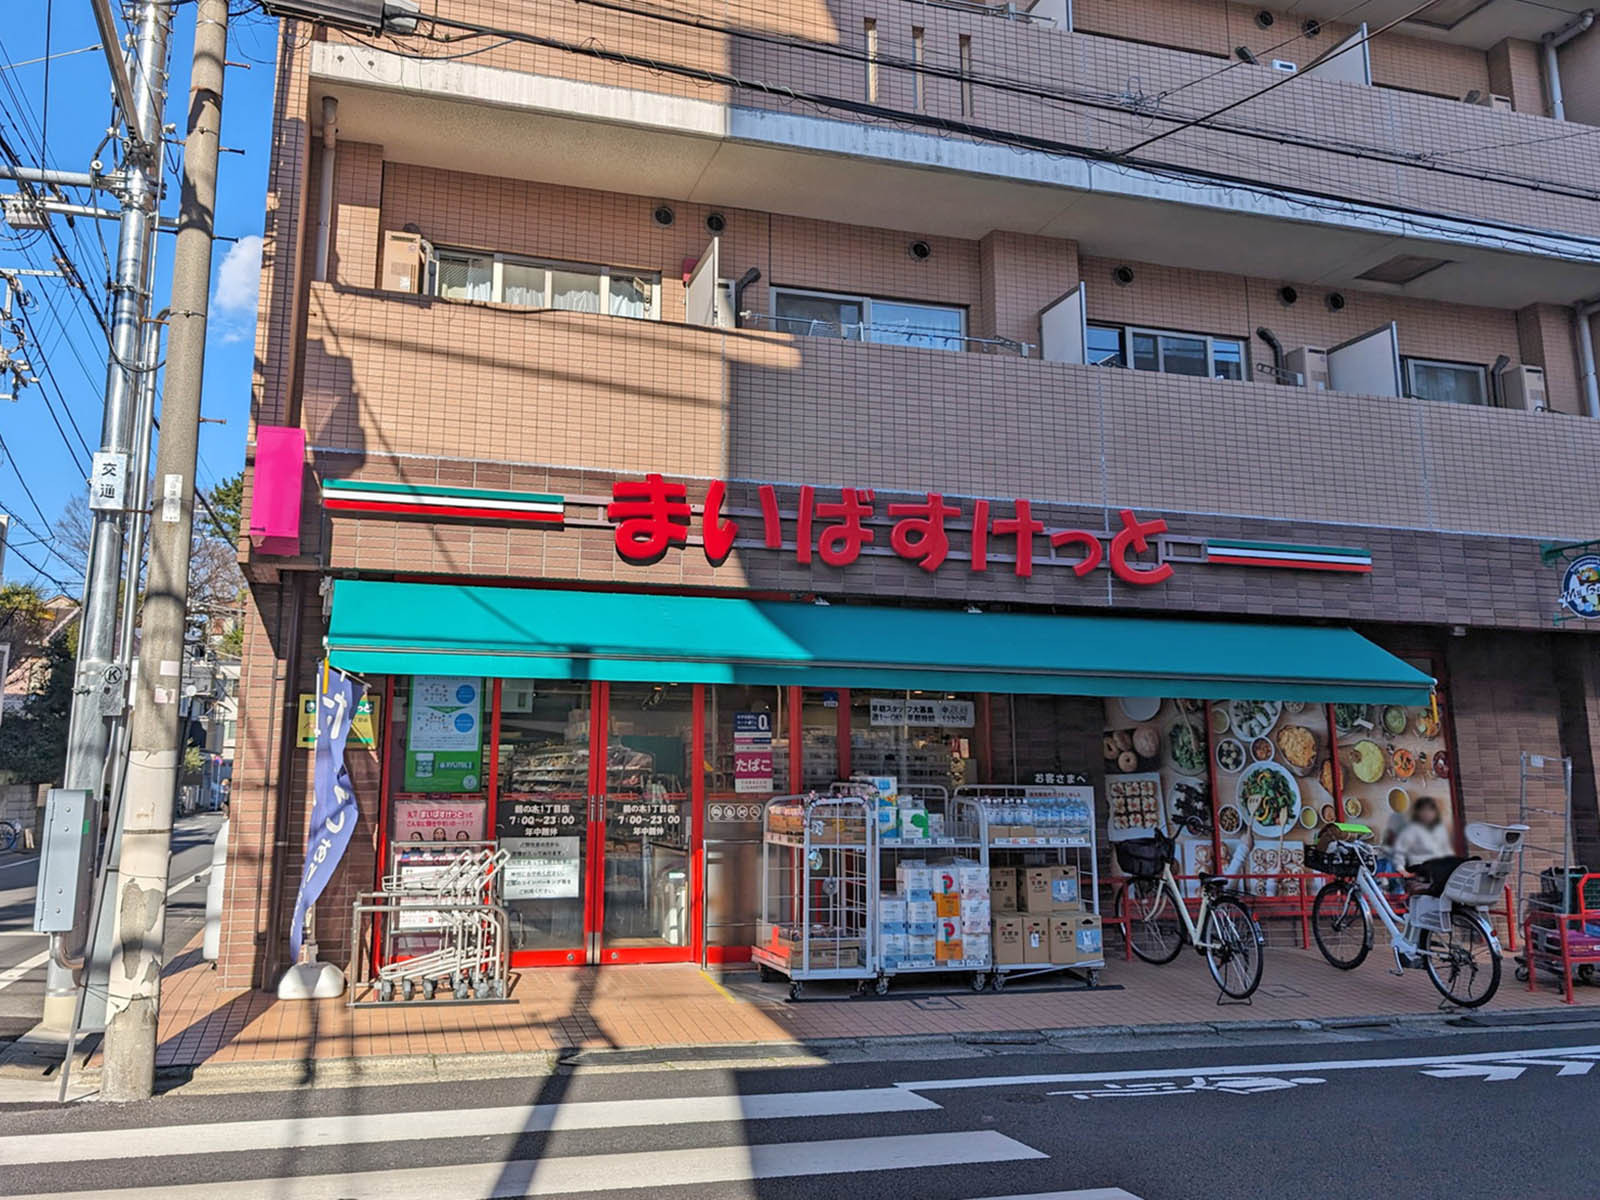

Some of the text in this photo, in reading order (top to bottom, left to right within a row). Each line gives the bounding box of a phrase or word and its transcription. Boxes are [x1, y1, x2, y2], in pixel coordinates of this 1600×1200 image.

[99, 462, 117, 499] 交通
[607, 473, 1175, 585] まいばすけっと
[736, 758, 772, 772] たばこ
[1035, 772, 1086, 784] お客さまへ
